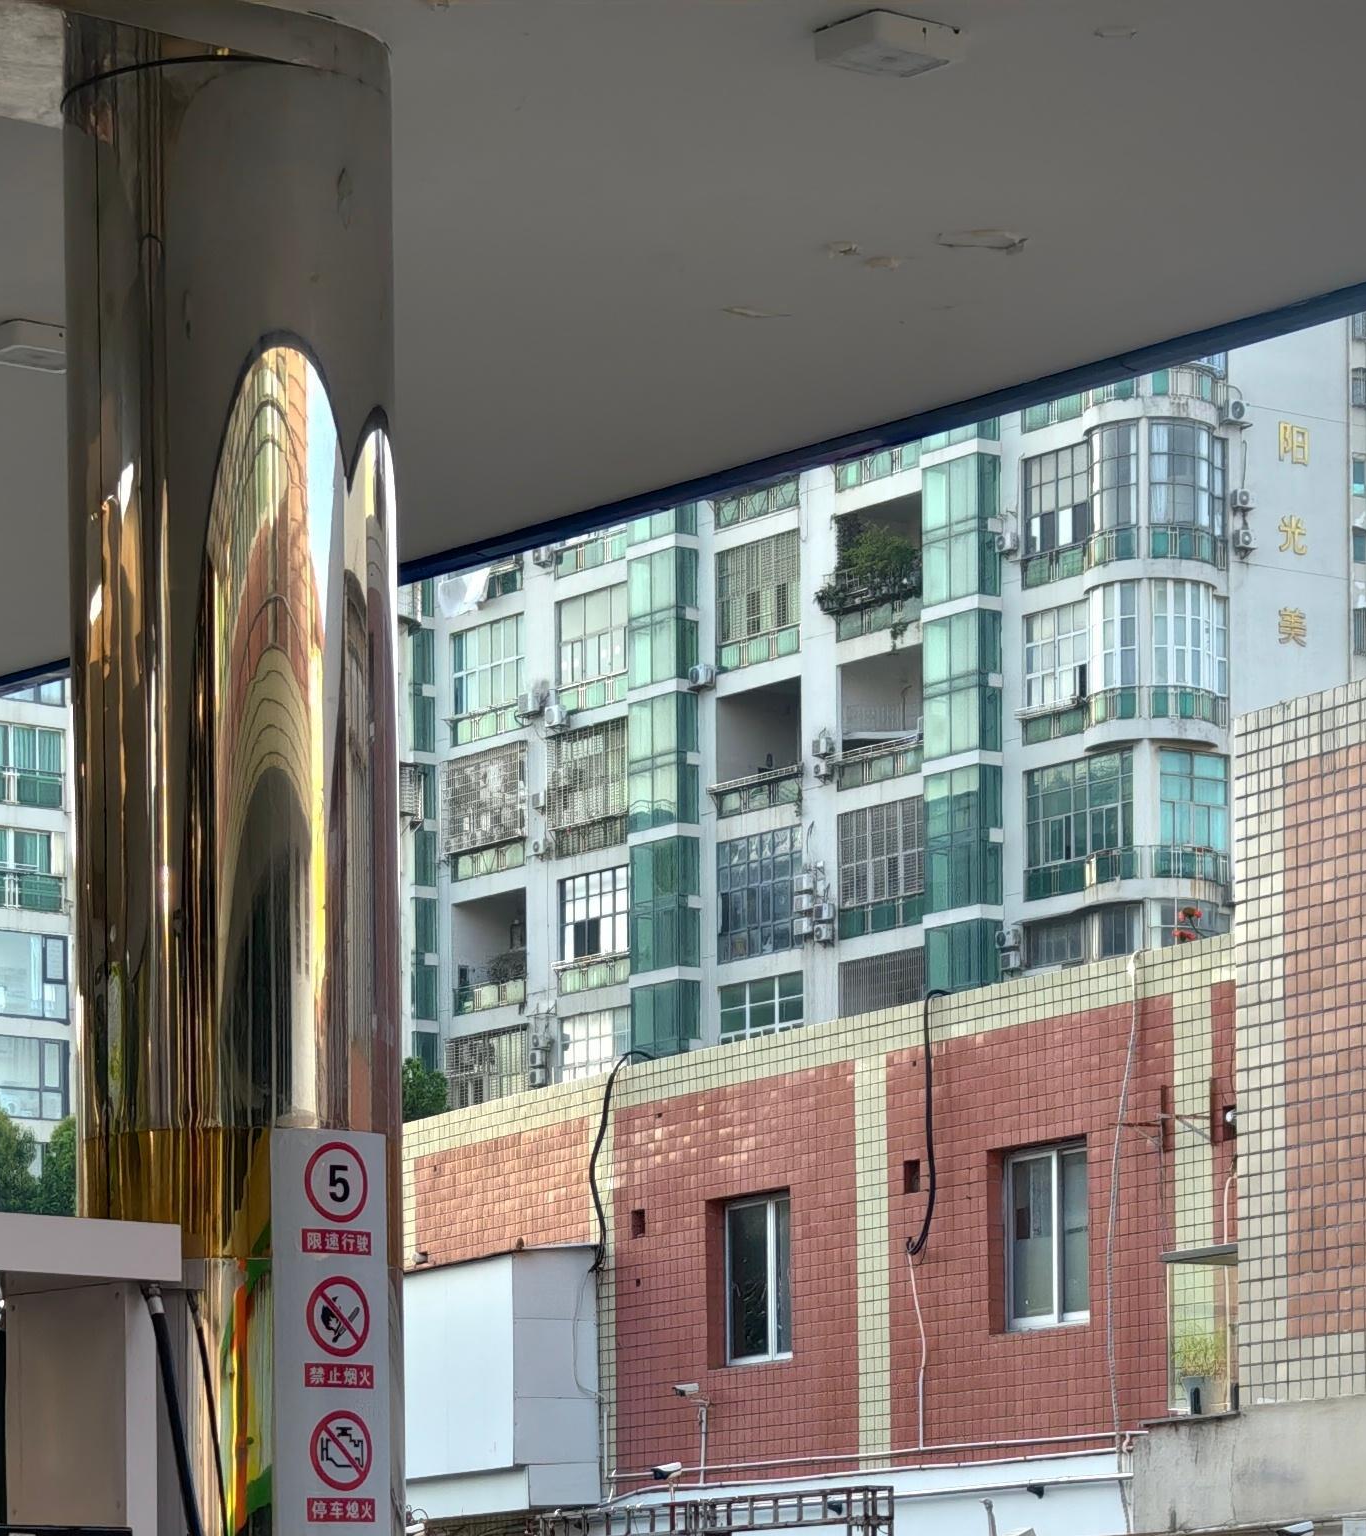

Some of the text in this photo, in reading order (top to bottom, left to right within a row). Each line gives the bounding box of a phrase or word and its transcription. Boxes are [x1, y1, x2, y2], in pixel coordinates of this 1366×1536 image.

[327, 1165, 350, 1203] 5
[306, 1232, 369, 1254] 限速行驶
[309, 1365, 372, 1387] 禁止烟火
[312, 1500, 373, 1521] 停车熄火
